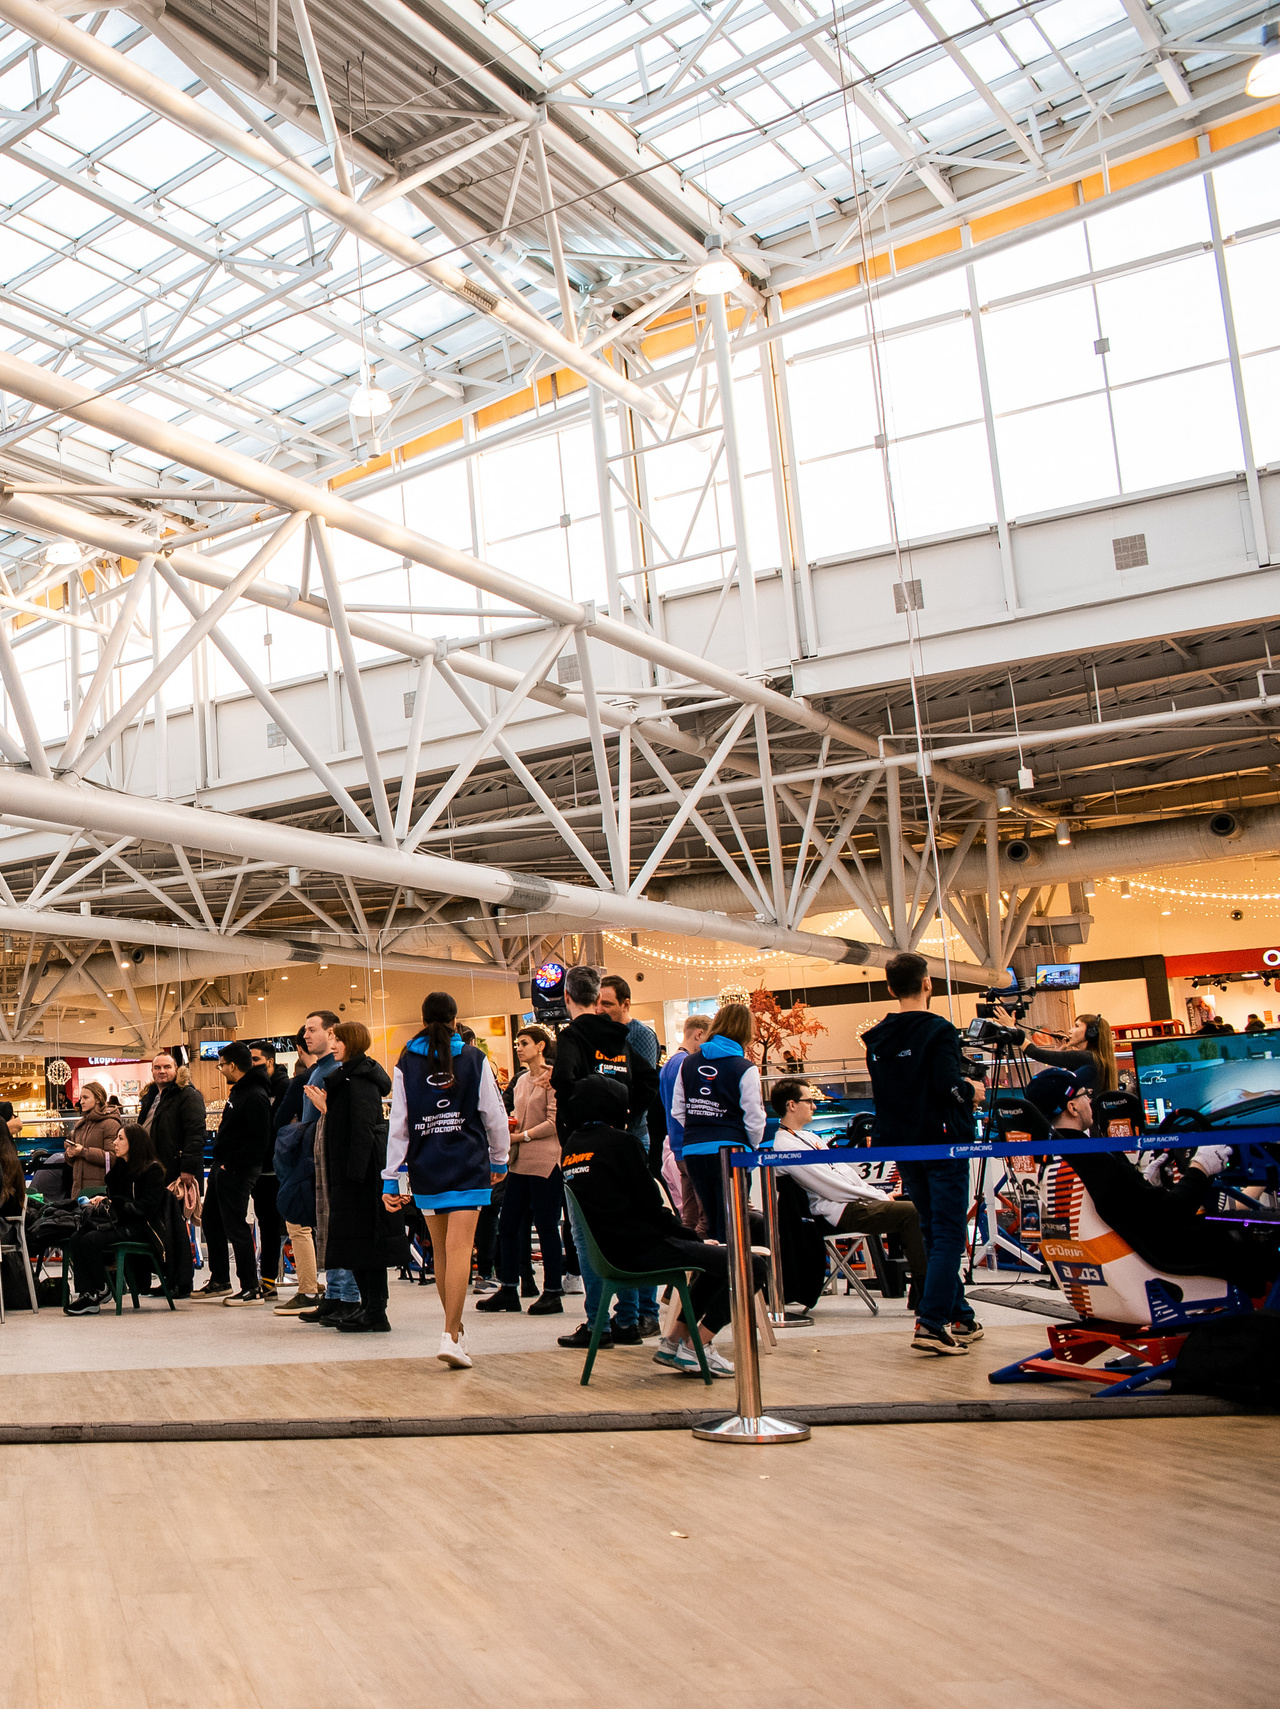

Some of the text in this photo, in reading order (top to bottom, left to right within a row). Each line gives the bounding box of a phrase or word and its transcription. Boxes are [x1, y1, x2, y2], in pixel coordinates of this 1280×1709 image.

[1156, 1135, 1179, 1143] RACING
[970, 1144, 993, 1152] RACING
[778, 1152, 802, 1160] RACING
[857, 1161, 886, 1180] 31
